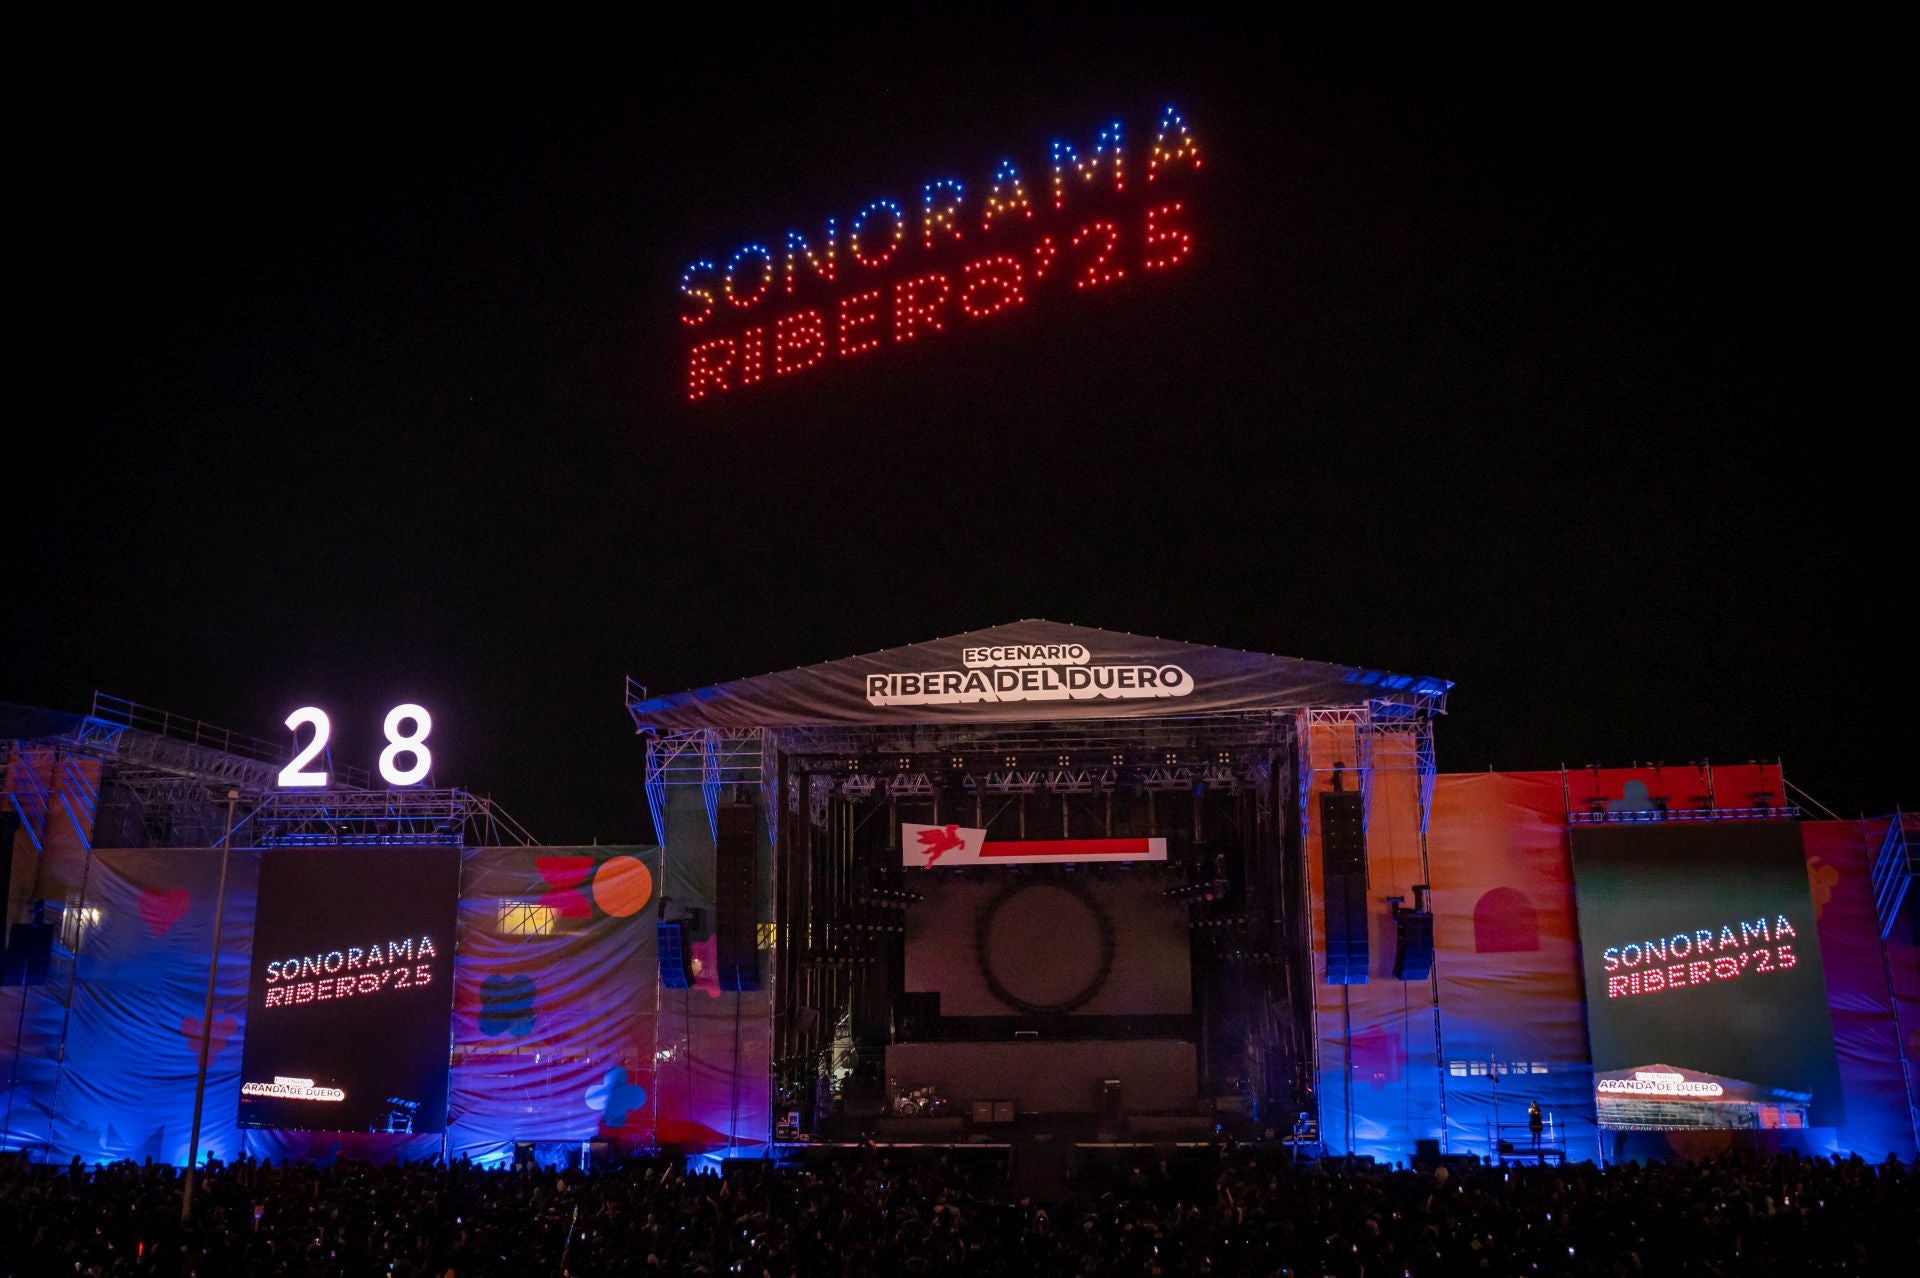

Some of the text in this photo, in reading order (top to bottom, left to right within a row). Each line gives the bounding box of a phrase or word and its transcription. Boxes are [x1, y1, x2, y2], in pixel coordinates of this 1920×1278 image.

[681, 106, 1202, 326] SONORAMA
[964, 645, 1084, 663] ESCENARIO
[869, 667, 1183, 698] RIBERA DEL DUERO
[1603, 915, 1796, 973] SONORAMA
[266, 936, 437, 984] SONORAMA
[244, 1084, 341, 1097] ARANDA DE DUERO
[1600, 1081, 1718, 1092] ARANDA DE DUERO
